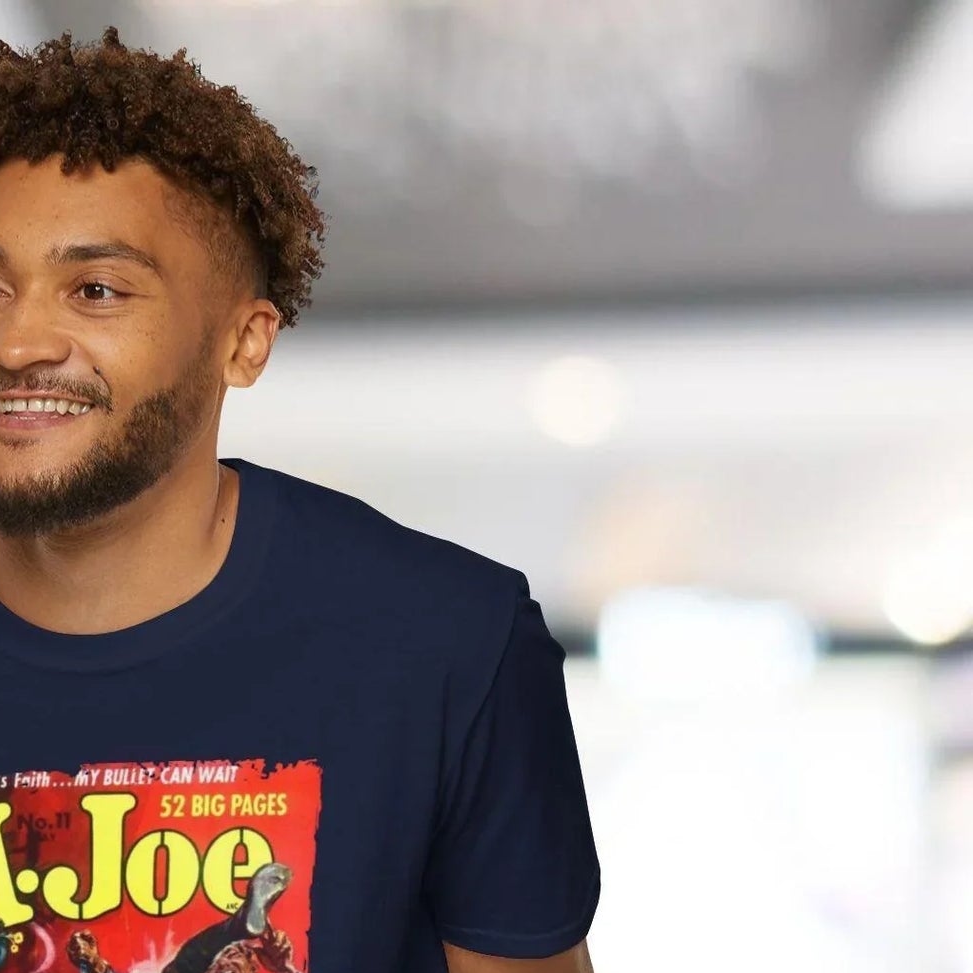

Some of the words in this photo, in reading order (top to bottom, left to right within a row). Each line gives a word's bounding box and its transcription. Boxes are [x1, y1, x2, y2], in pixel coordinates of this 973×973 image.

[103, 767, 156, 786] BULLET
[160, 766, 194, 785] CAN
[198, 765, 239, 784] WAIT
[159, 794, 185, 817] 52
[191, 794, 225, 817] BIG
[231, 793, 287, 816] PAGES
